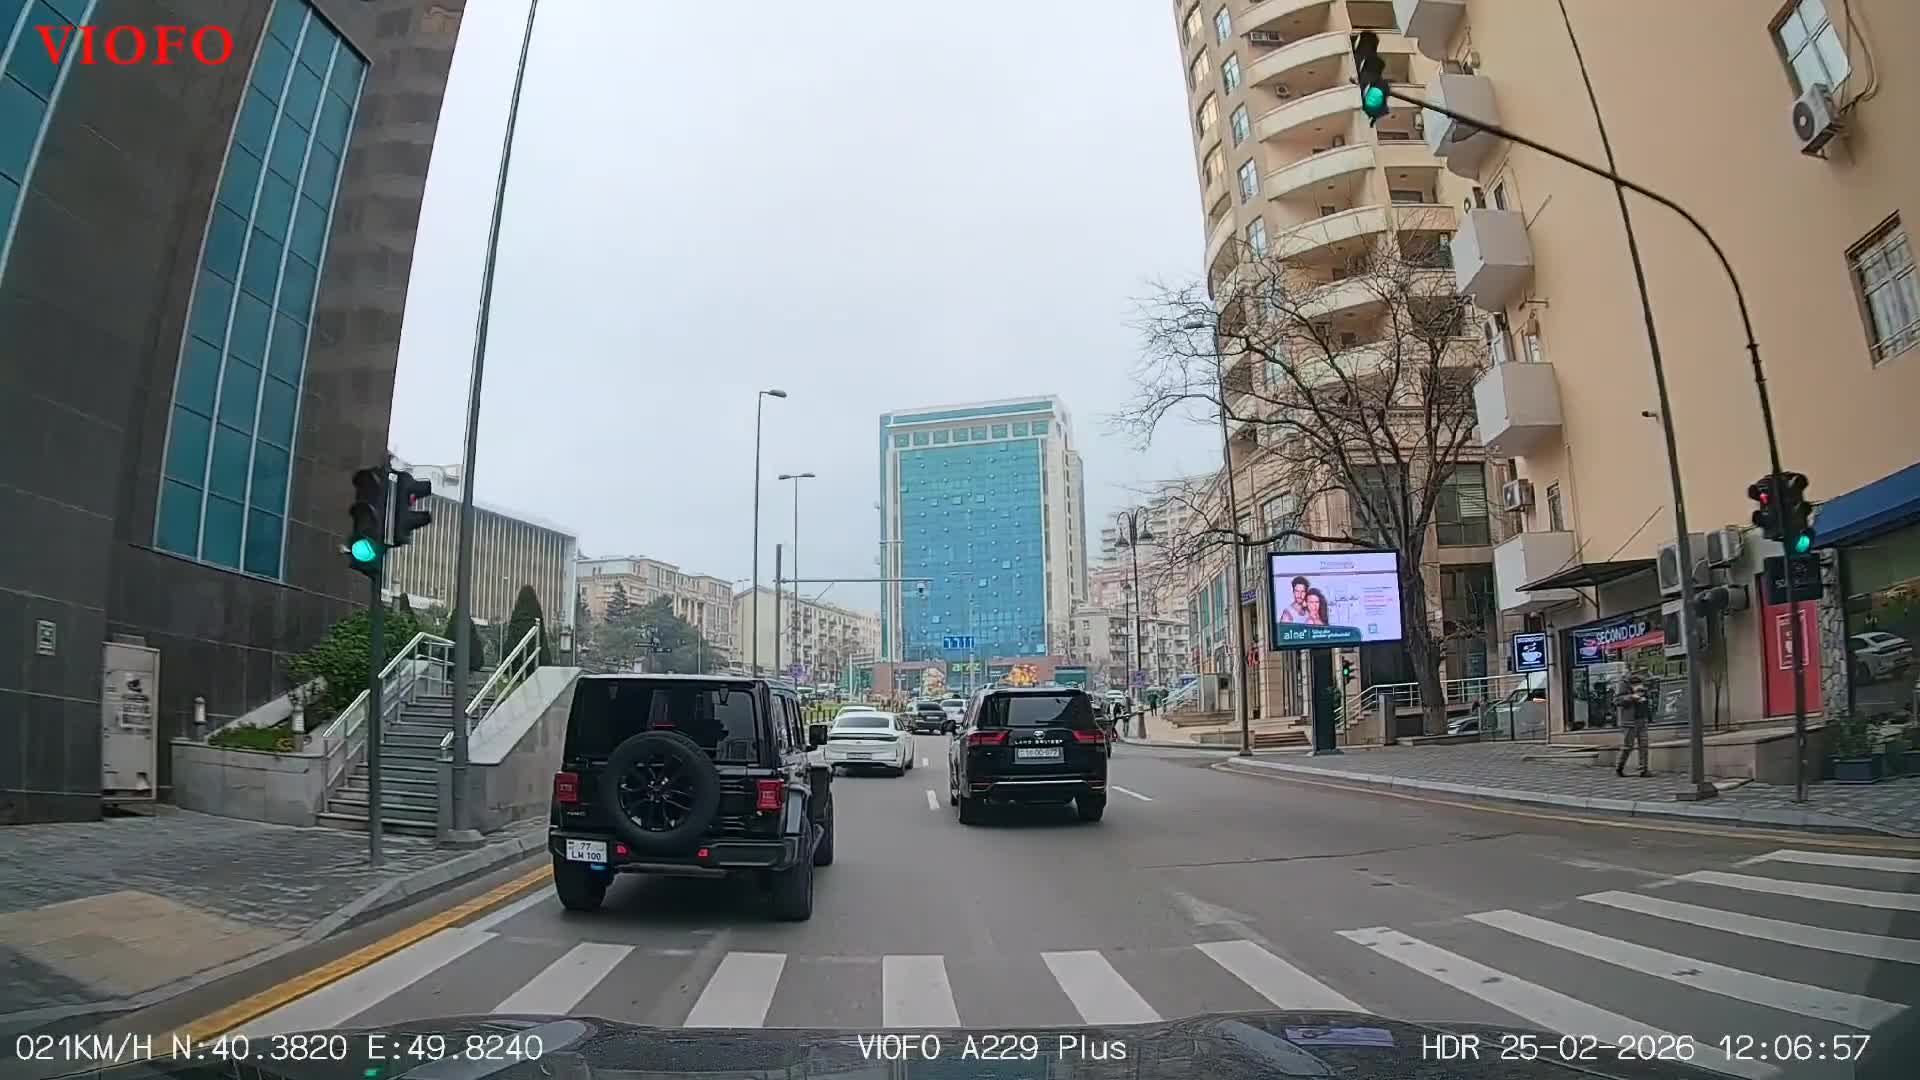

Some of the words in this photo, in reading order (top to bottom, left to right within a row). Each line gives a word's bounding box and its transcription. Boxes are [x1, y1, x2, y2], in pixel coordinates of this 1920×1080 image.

[1596, 626, 1627, 643] SECOND
[1629, 622, 1645, 637] CUP
[580, 842, 591, 850] 77
[587, 852, 601, 861] 100
